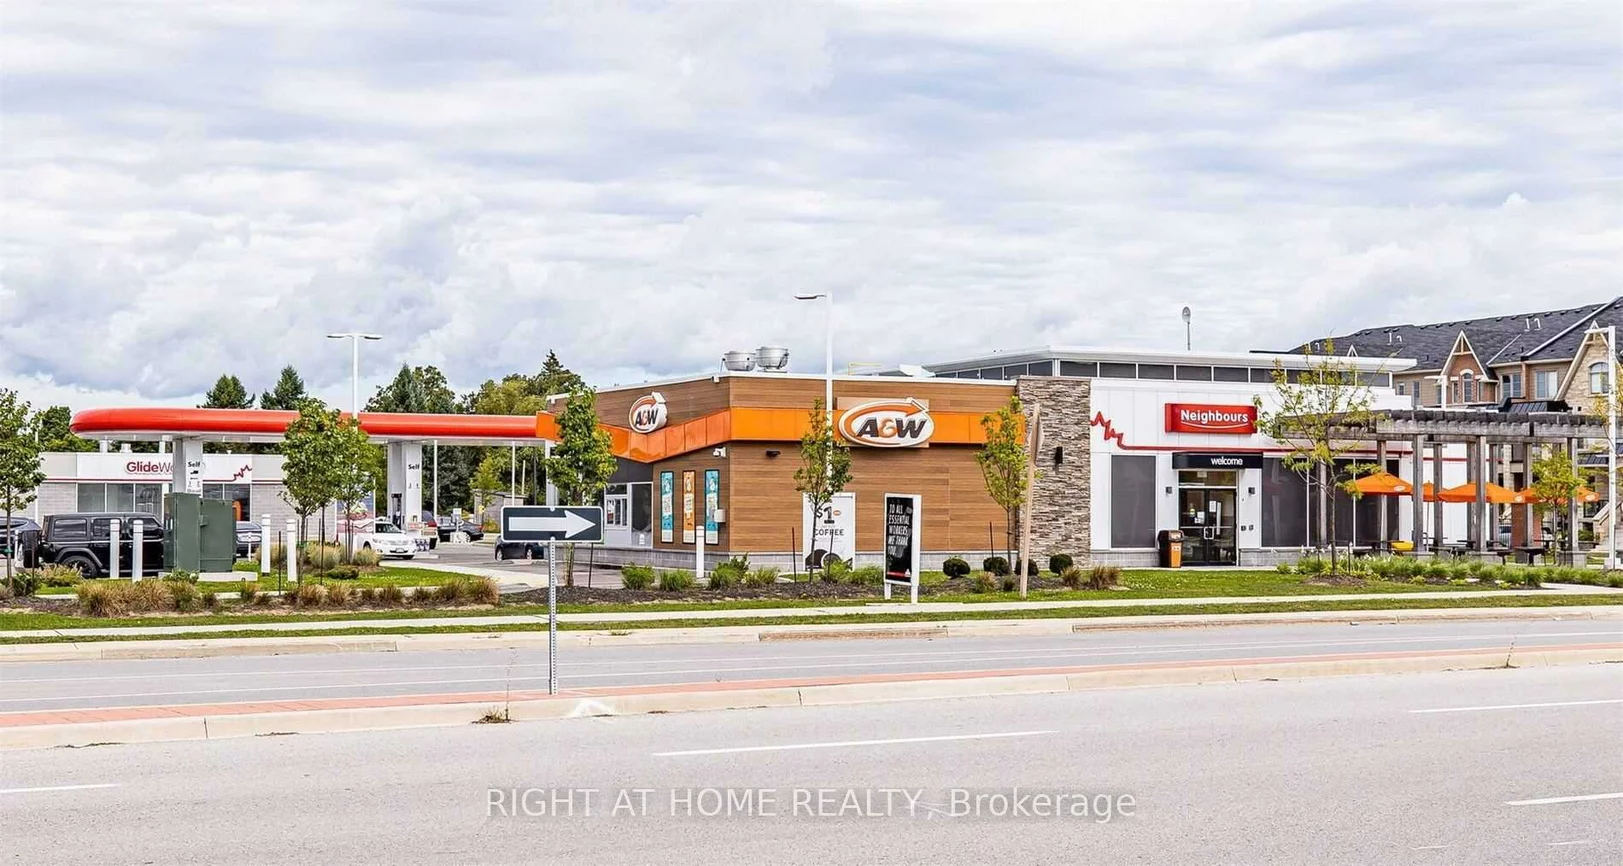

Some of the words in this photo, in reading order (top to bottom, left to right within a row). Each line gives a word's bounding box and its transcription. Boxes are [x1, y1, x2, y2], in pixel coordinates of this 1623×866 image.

[635, 409, 658, 425] A&W
[1181, 410, 1248, 424] Neighbours
[856, 416, 927, 438] A&W
[1211, 456, 1243, 465] welcome
[888, 514, 910, 525] ESSENTIAL
